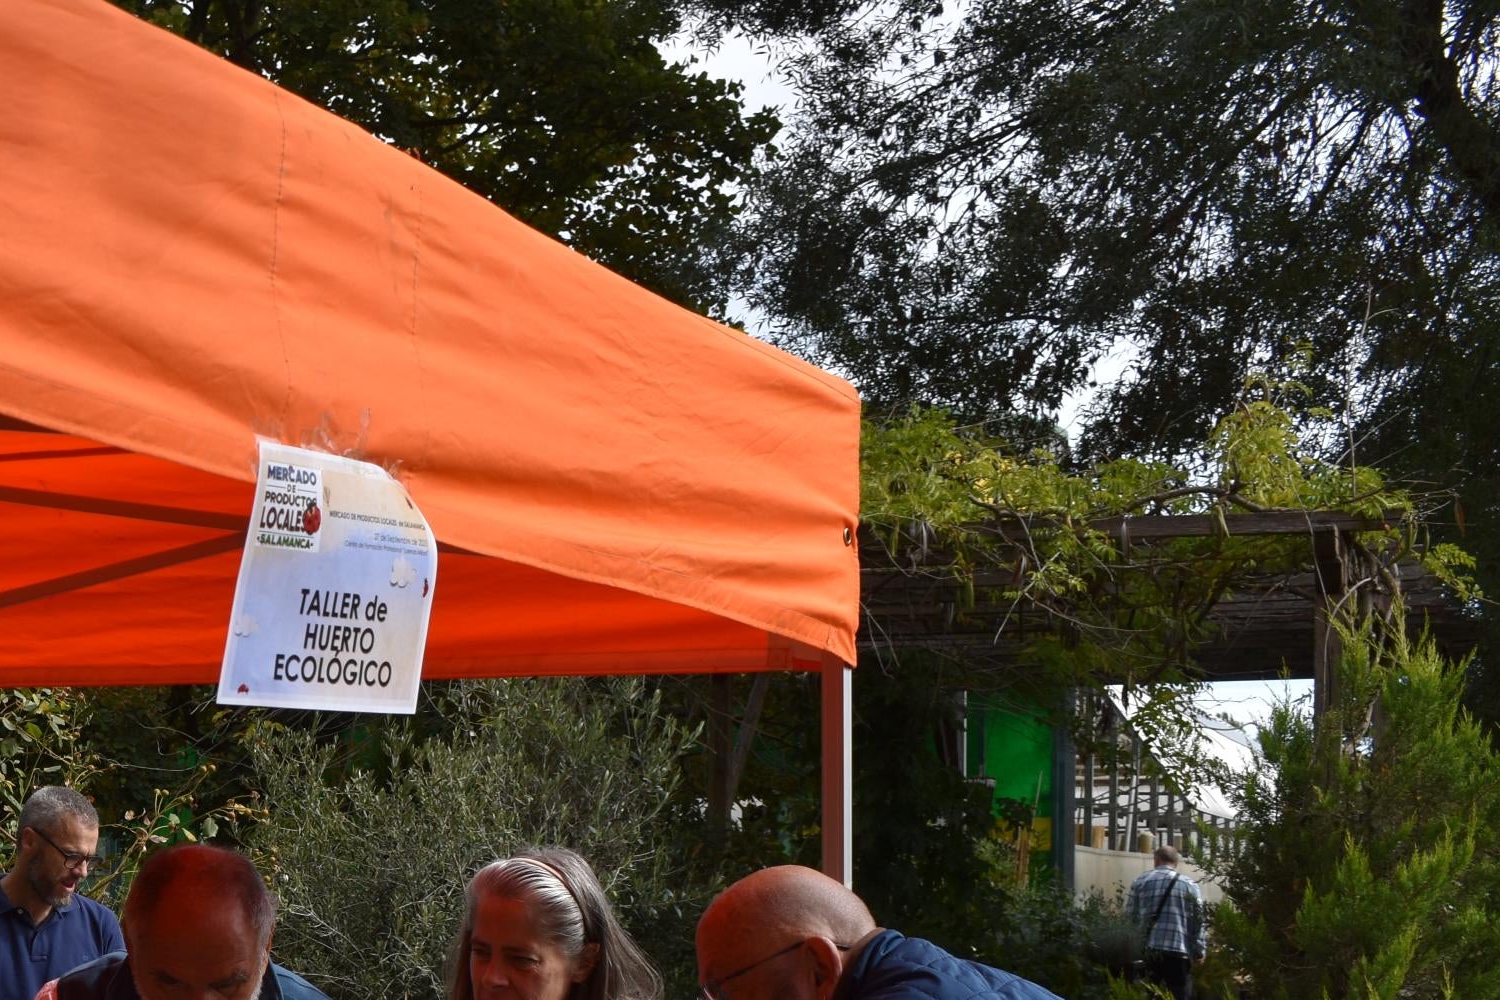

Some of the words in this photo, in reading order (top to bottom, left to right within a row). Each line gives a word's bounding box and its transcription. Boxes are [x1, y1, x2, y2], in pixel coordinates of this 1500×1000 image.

[267, 465, 317, 485] MERCADO
[286, 484, 297, 493] DE
[329, 511, 350, 520] MERCADO
[357, 514, 380, 523] PRODUCTOS
[300, 588, 360, 620] TALLER
[365, 595, 387, 622] de
[303, 623, 375, 654] HUERTO
[273, 650, 392, 687] ECOLÓGICO
